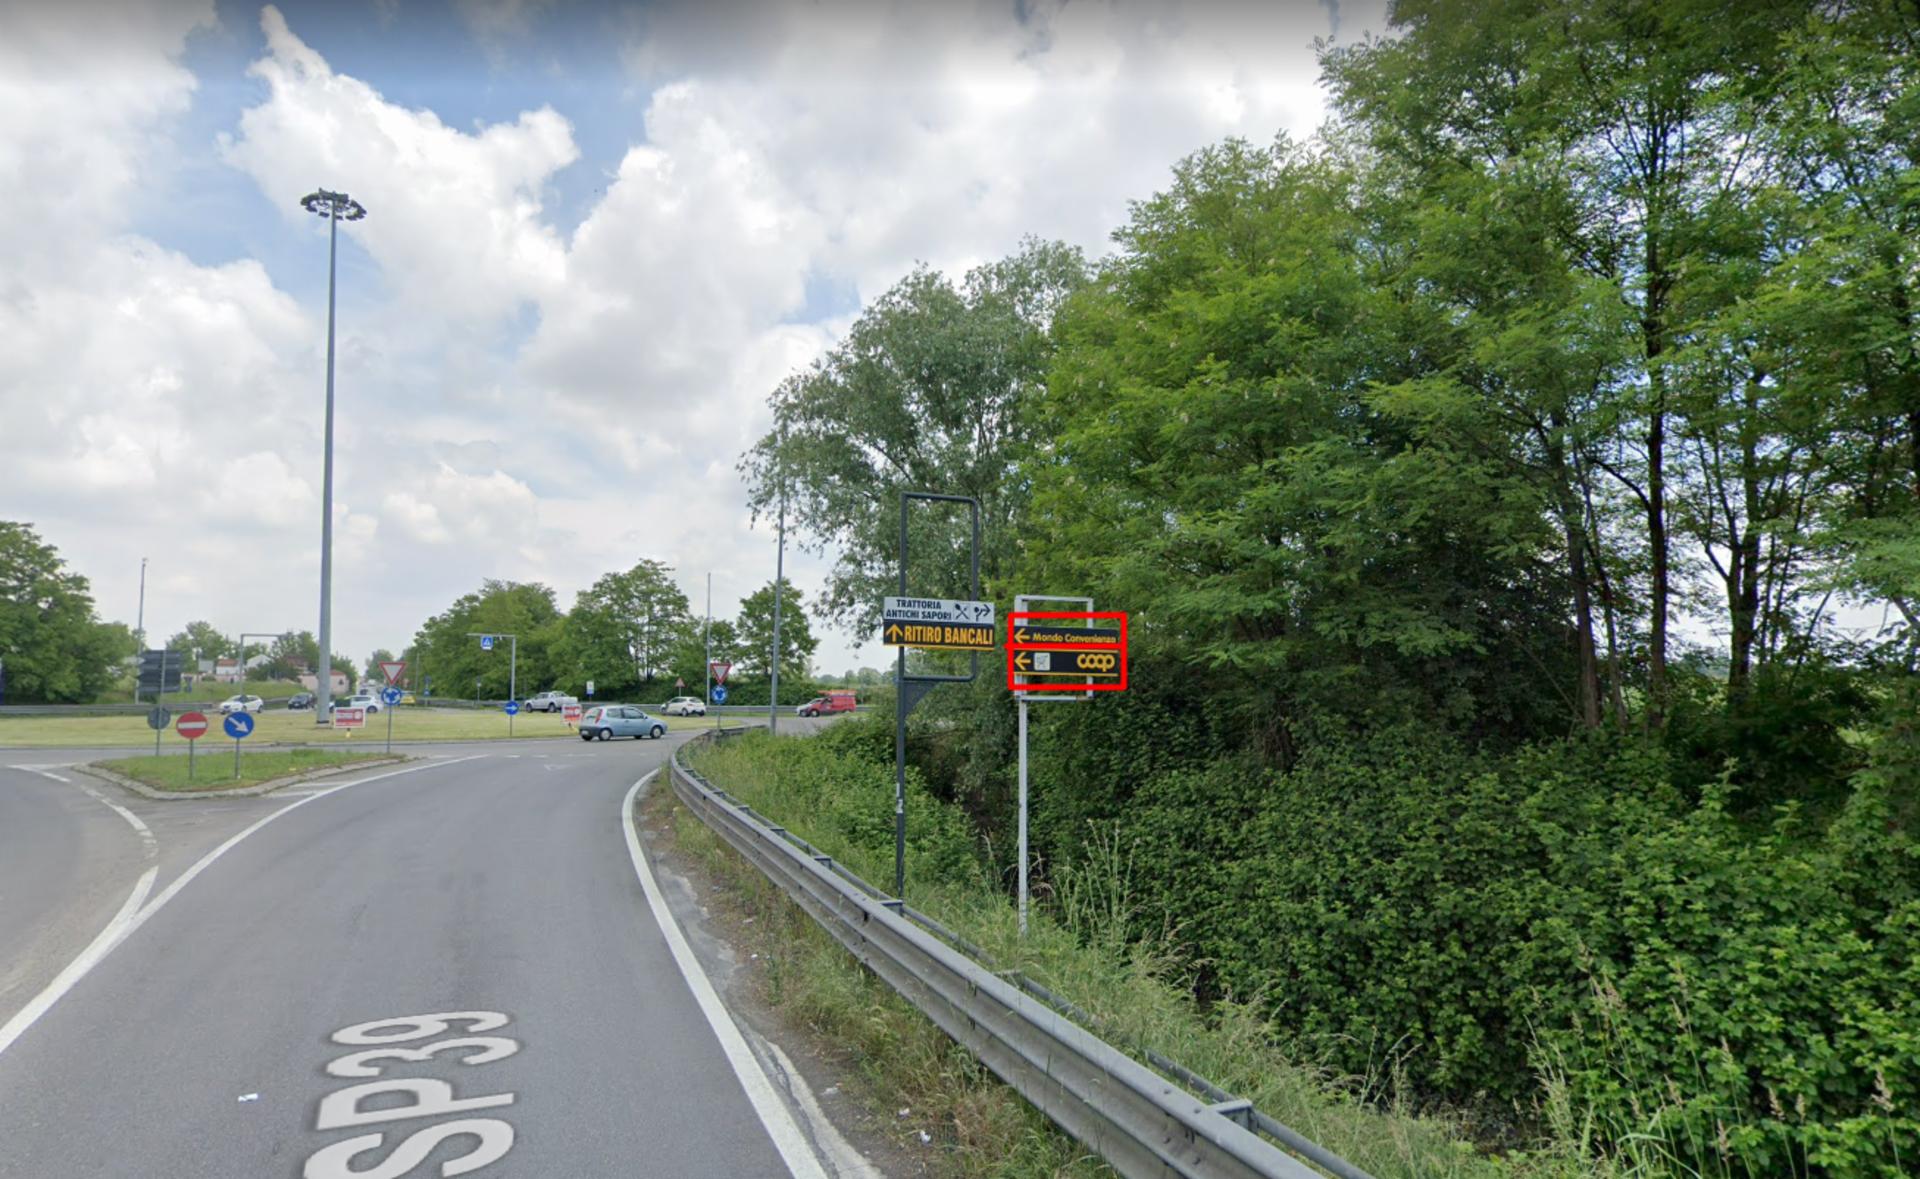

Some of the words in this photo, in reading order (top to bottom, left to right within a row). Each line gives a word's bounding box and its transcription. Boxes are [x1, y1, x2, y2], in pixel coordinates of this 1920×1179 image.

[896, 599, 942, 609] TRATTORIA
[886, 609, 920, 619] ANTICHI
[921, 610, 952, 620] SAPORI
[904, 625, 942, 643] RITIRO
[944, 627, 993, 645] BANCALI
[1032, 632, 1064, 642] Mondo
[302, 1010, 520, 1179] SP39
